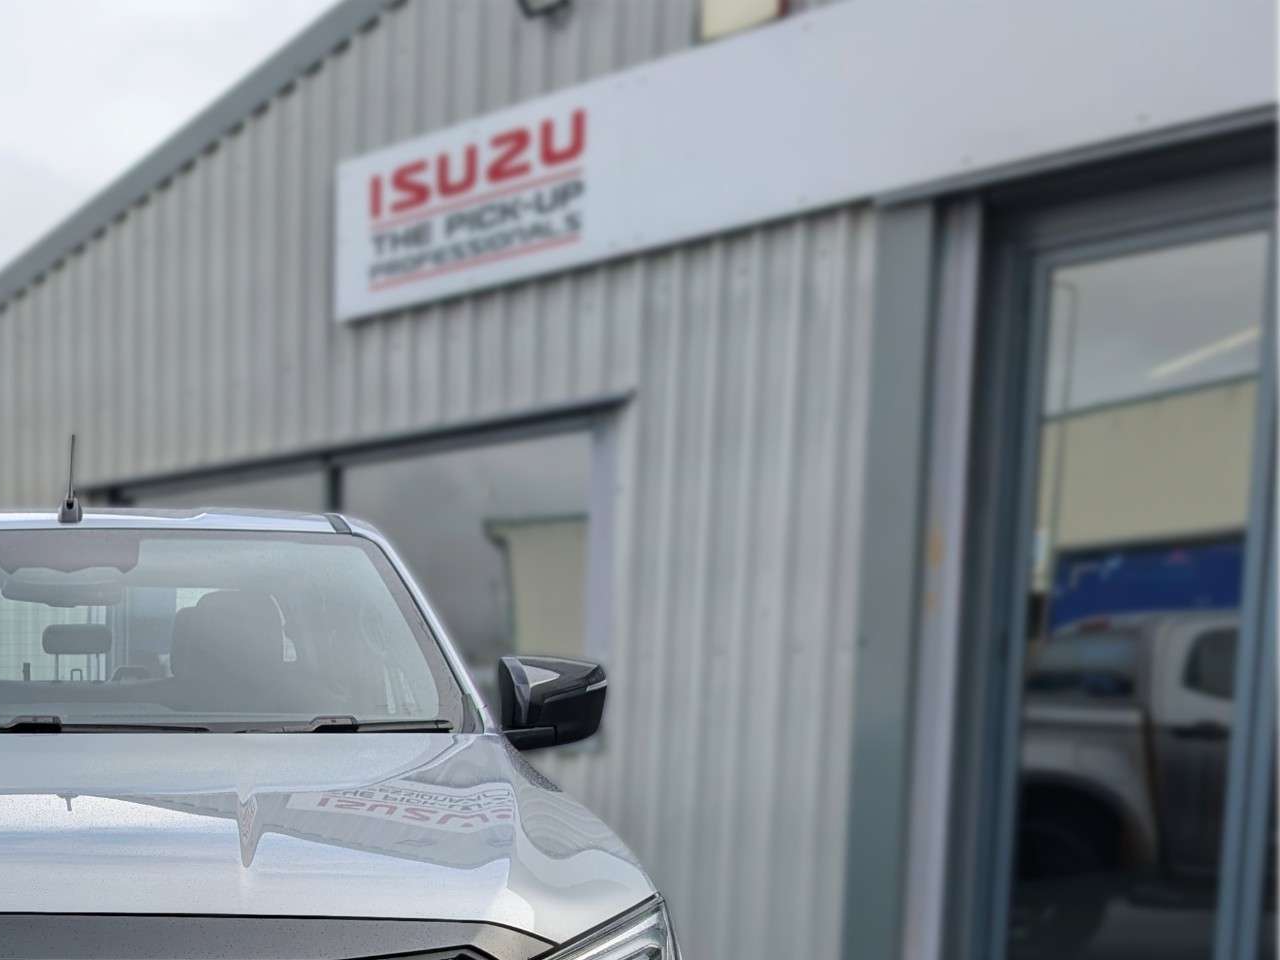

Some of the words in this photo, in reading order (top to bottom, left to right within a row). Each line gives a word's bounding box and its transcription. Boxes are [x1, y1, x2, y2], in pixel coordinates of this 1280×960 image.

[369, 108, 586, 219] ISUZU
[372, 222, 432, 254] THE
[444, 179, 584, 237] PICK-UP
